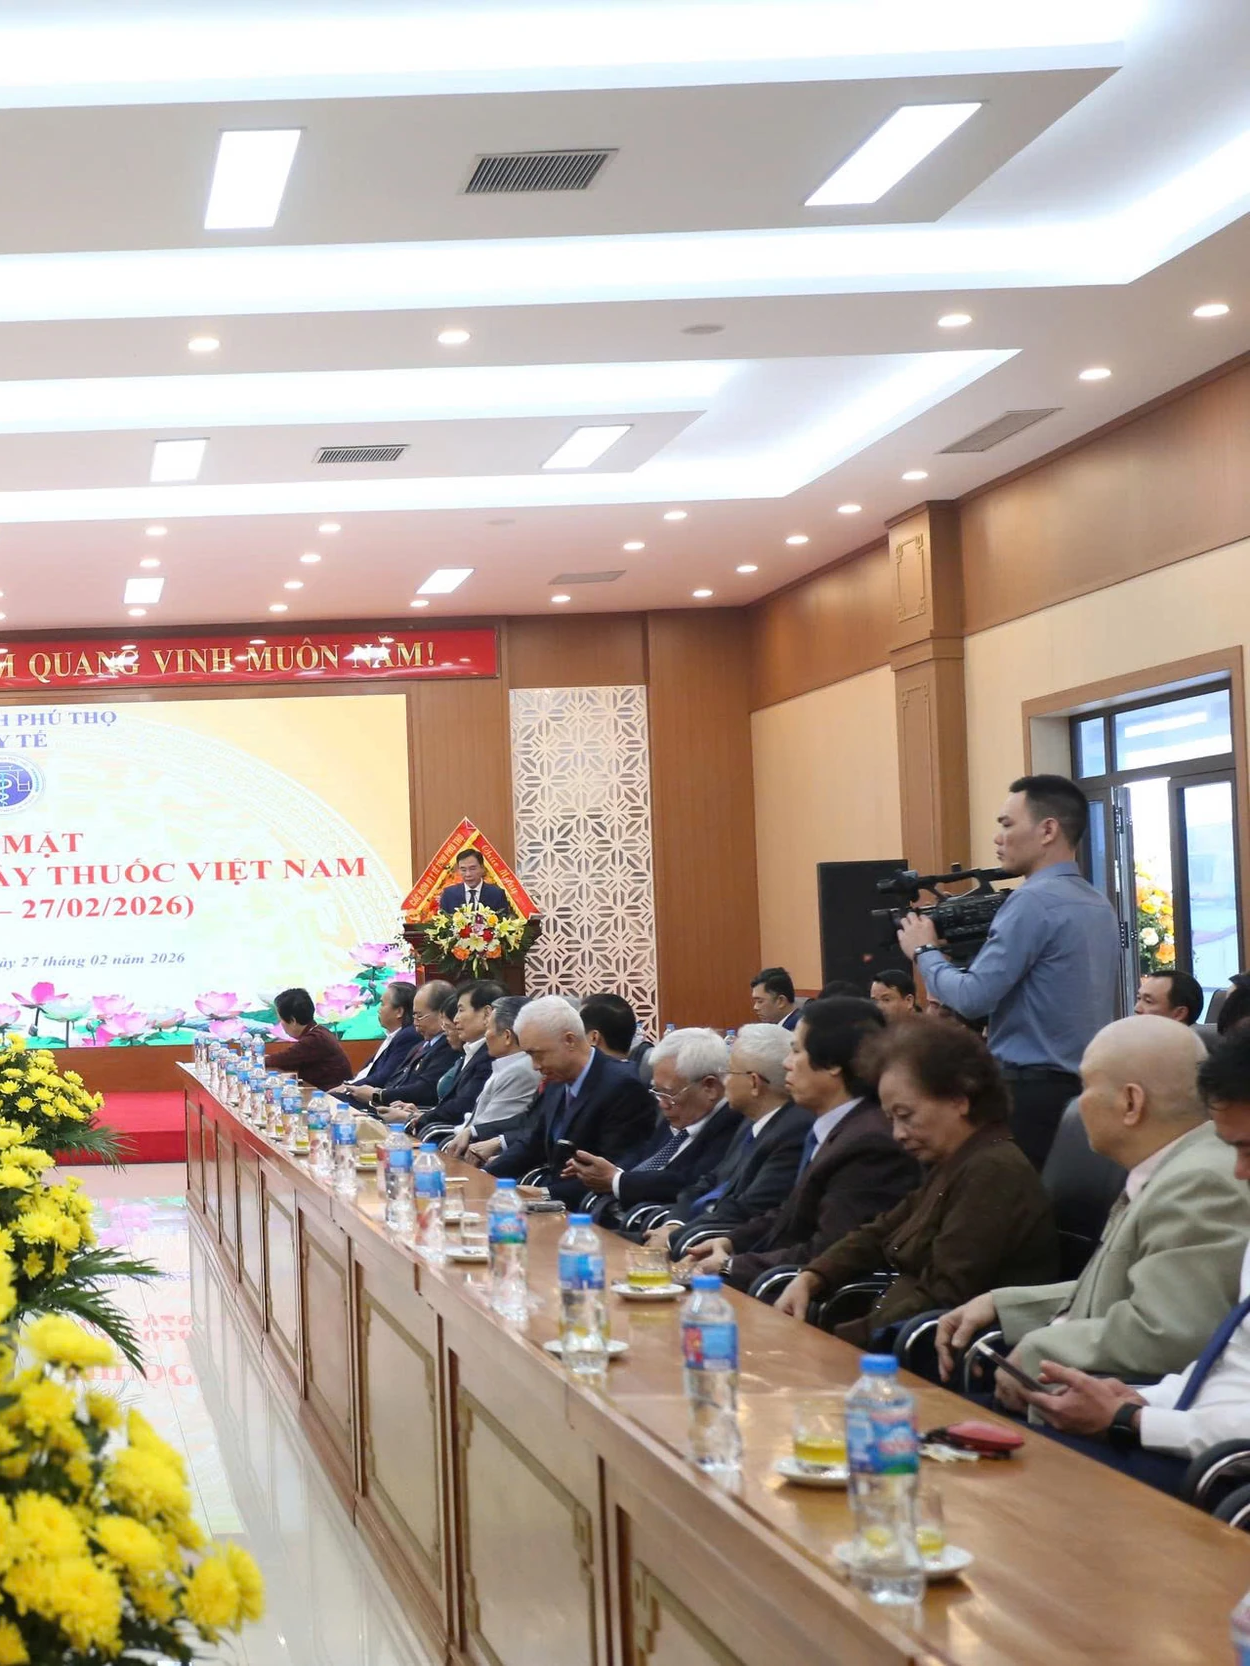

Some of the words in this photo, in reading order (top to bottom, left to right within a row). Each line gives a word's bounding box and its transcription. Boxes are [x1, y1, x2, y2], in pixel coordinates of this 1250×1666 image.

[28, 649, 141, 684] QUANG
[152, 646, 233, 674] VINH
[247, 637, 340, 672] MUÔN
[17, 709, 62, 726] PHÚ
[68, 711, 117, 727] THỌ
[3, 831, 84, 859] MẶT
[47, 858, 176, 886] THUỐC
[187, 858, 272, 886] VIỆT
[283, 857, 366, 880] NAM
[22, 895, 194, 919] 27/02/2026)
[21, 956, 39, 967] 27
[42, 954, 86, 968] tháng
[91, 954, 107, 966] 02
[112, 955, 145, 965] năm
[150, 952, 186, 964] 2026
